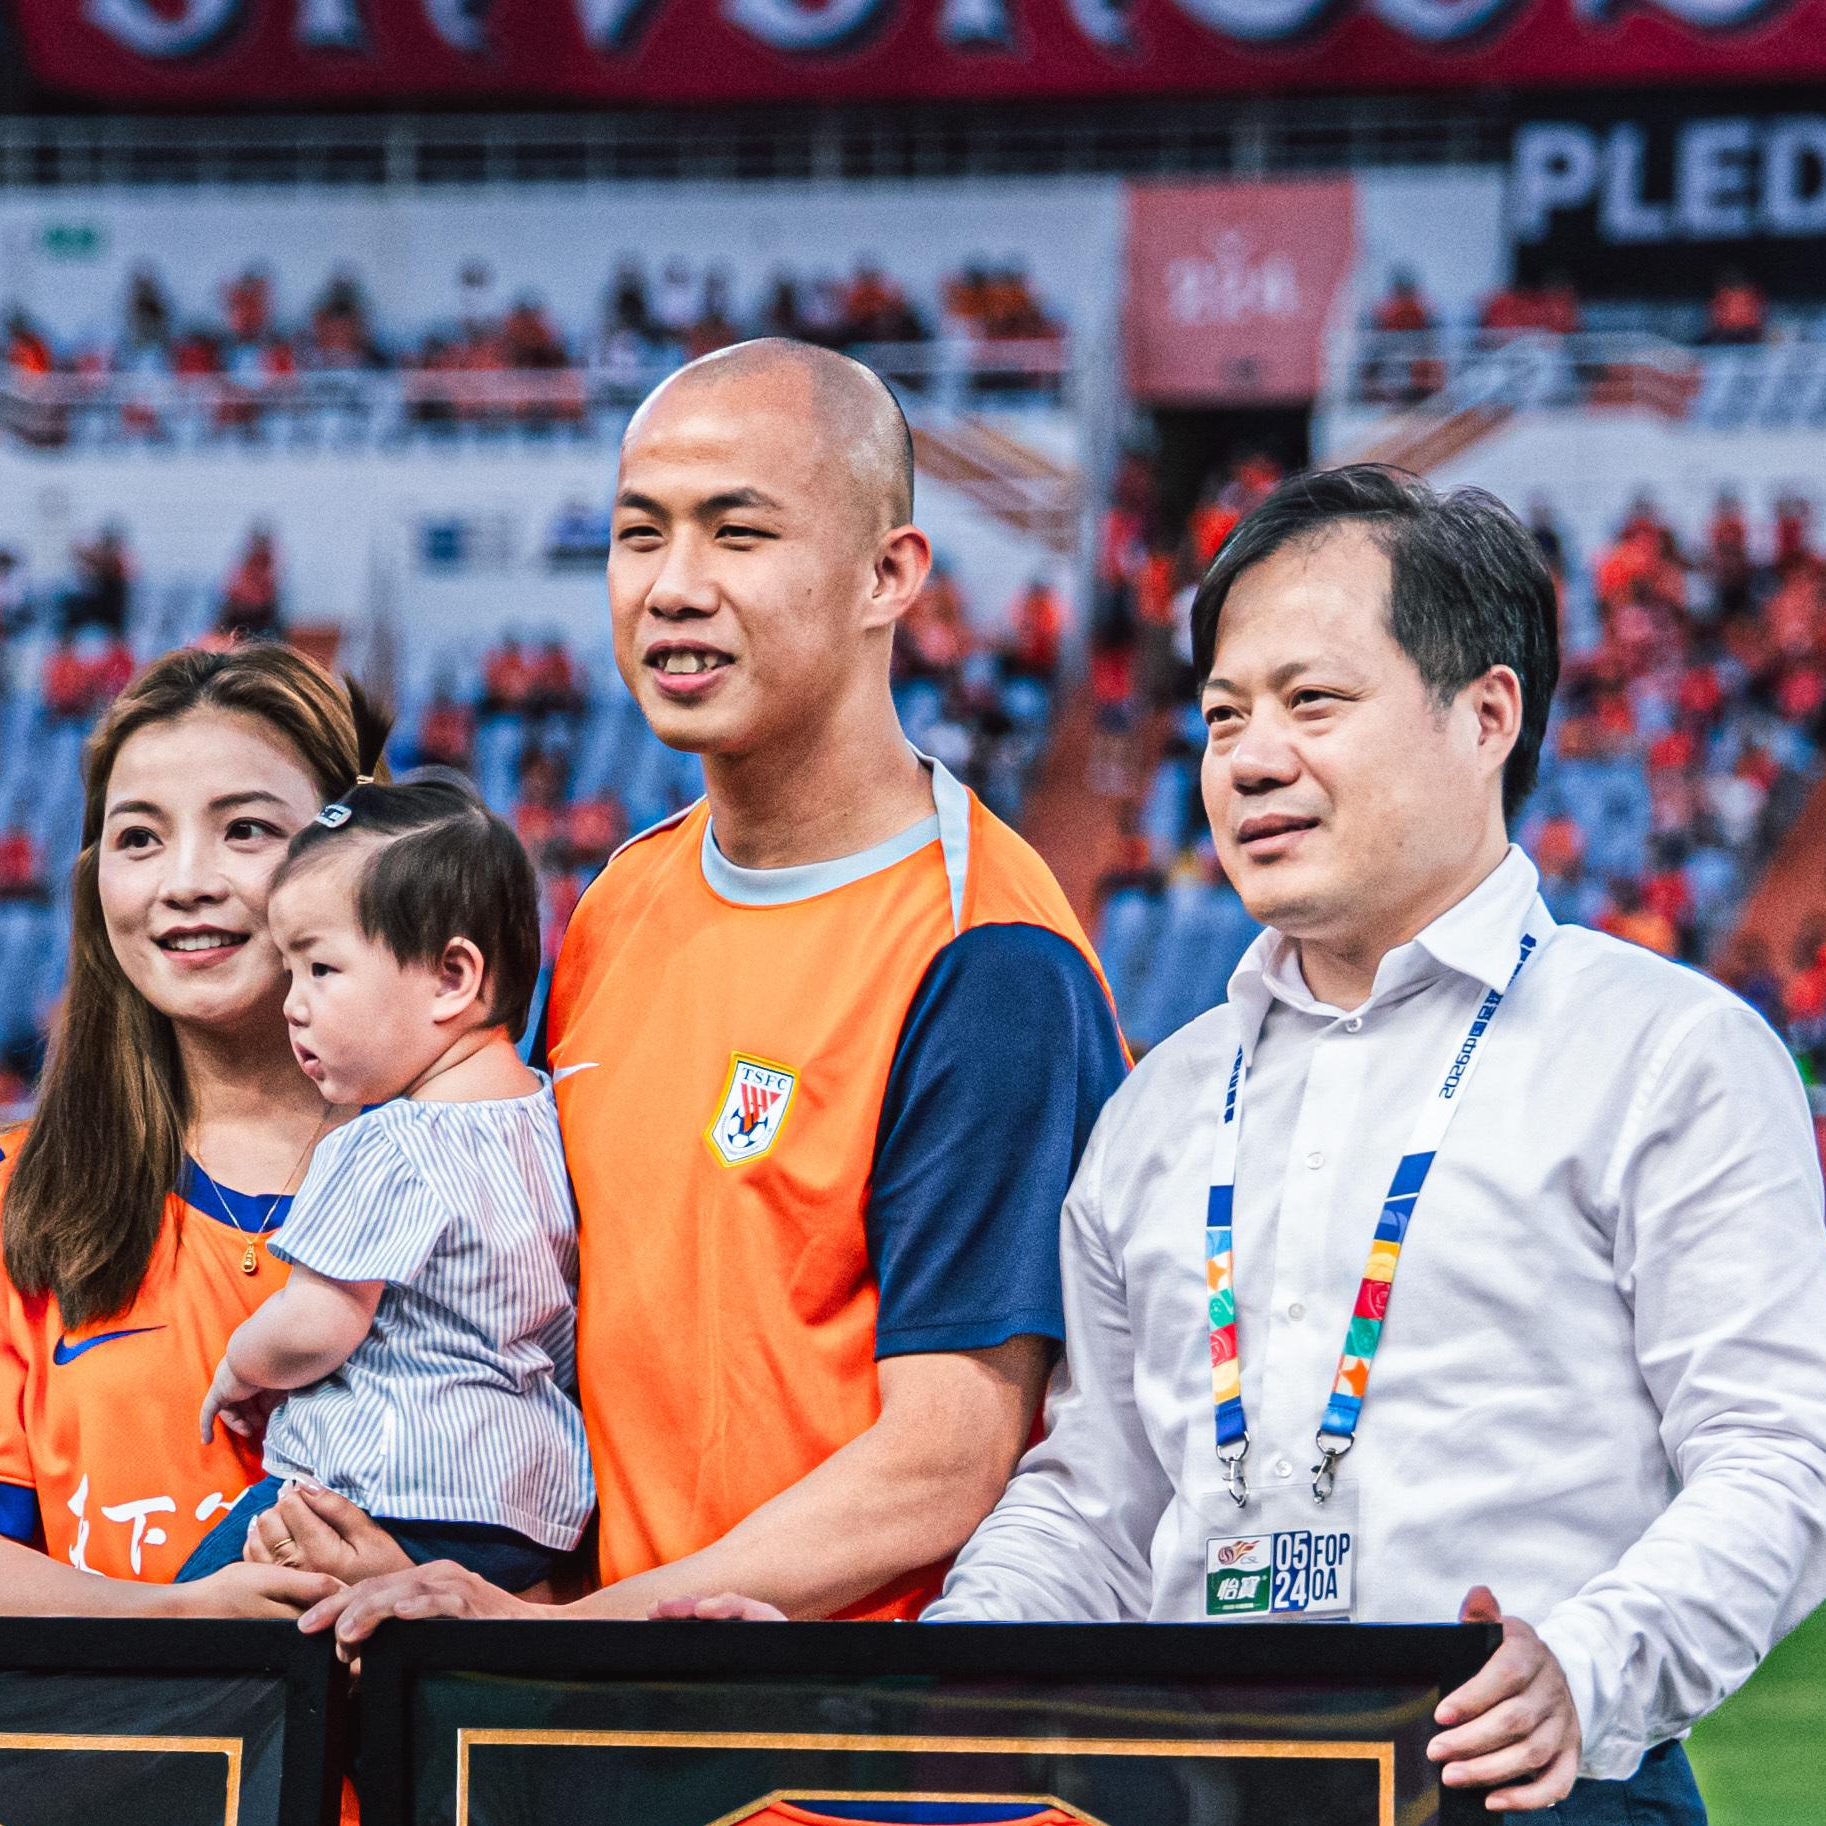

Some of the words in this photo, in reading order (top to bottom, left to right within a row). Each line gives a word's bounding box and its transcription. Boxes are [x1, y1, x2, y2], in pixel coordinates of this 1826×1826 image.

[742, 1067, 787, 1090] TSFC
[1276, 1532, 1308, 1571] 05
[1313, 1533, 1351, 1568] FOP
[1274, 1571, 1308, 1609] 24
[1311, 1568, 1338, 1601] OA
